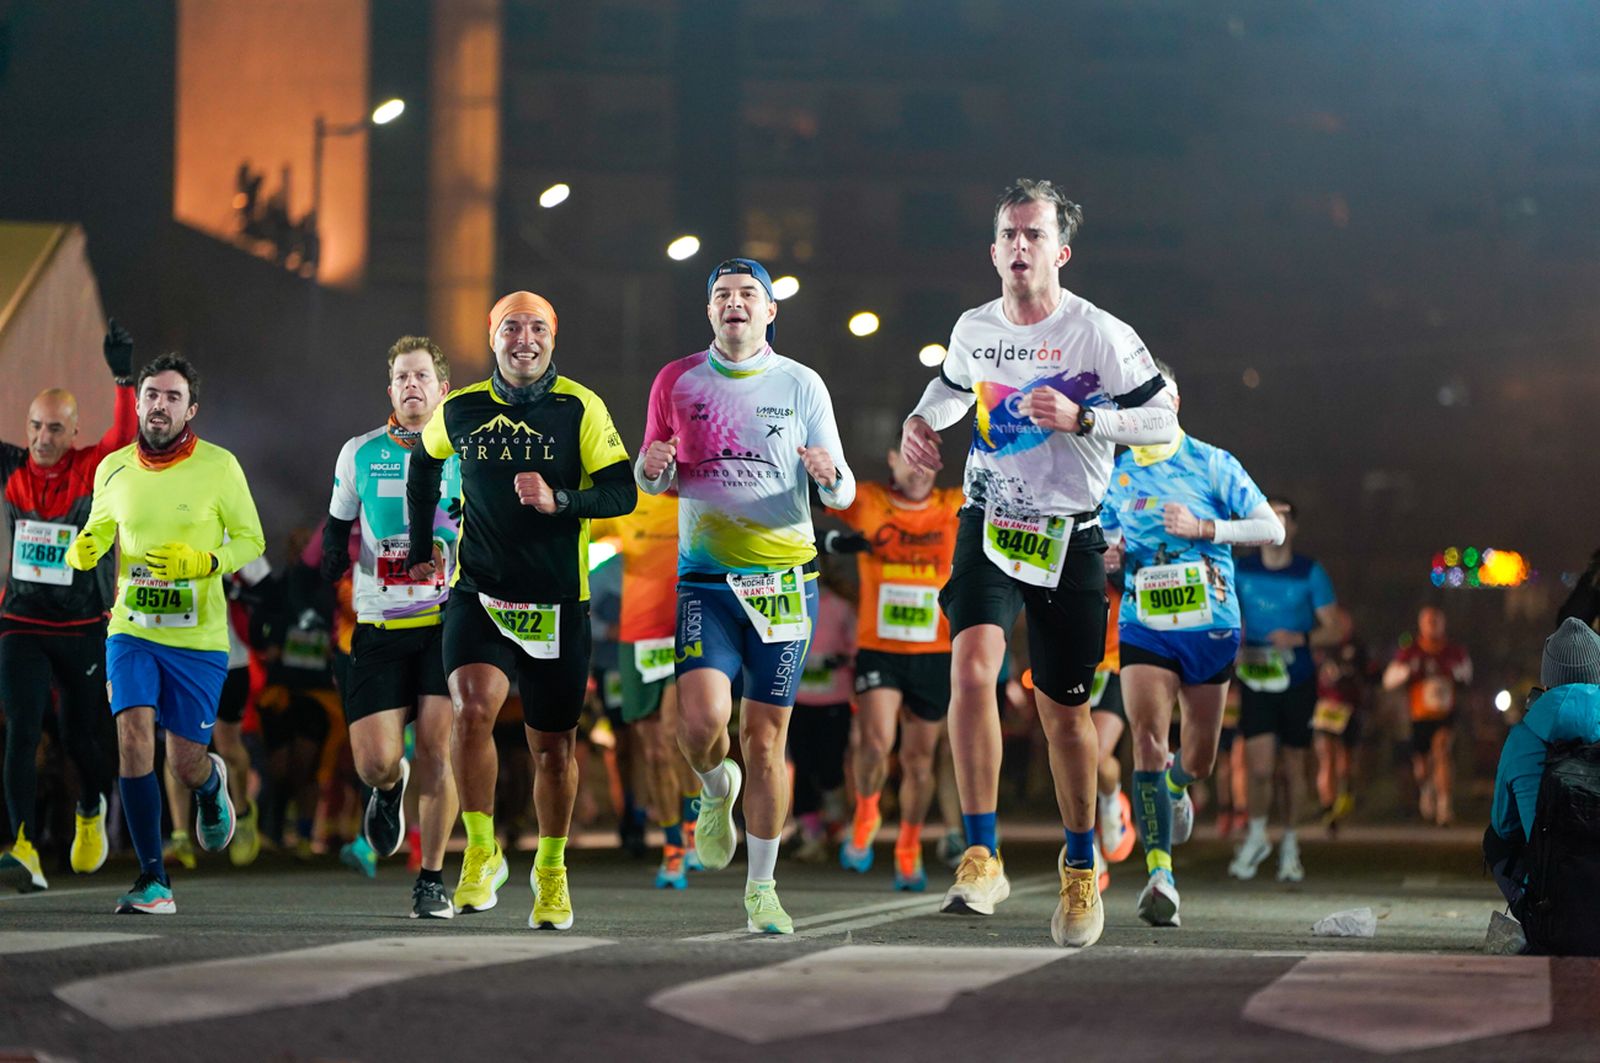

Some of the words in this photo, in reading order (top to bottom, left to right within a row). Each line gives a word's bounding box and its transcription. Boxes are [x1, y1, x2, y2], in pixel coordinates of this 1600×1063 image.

[972, 339, 1062, 368] calderón
[459, 436, 556, 445] ALPARGATA
[460, 445, 554, 461] TRAIL
[690, 469, 730, 479] CLARO
[21, 543, 66, 564] 12687
[996, 529, 1052, 560] 8404
[742, 579, 765, 588] NOCHE
[136, 587, 182, 608] 9574
[1150, 586, 1196, 609] 9002
